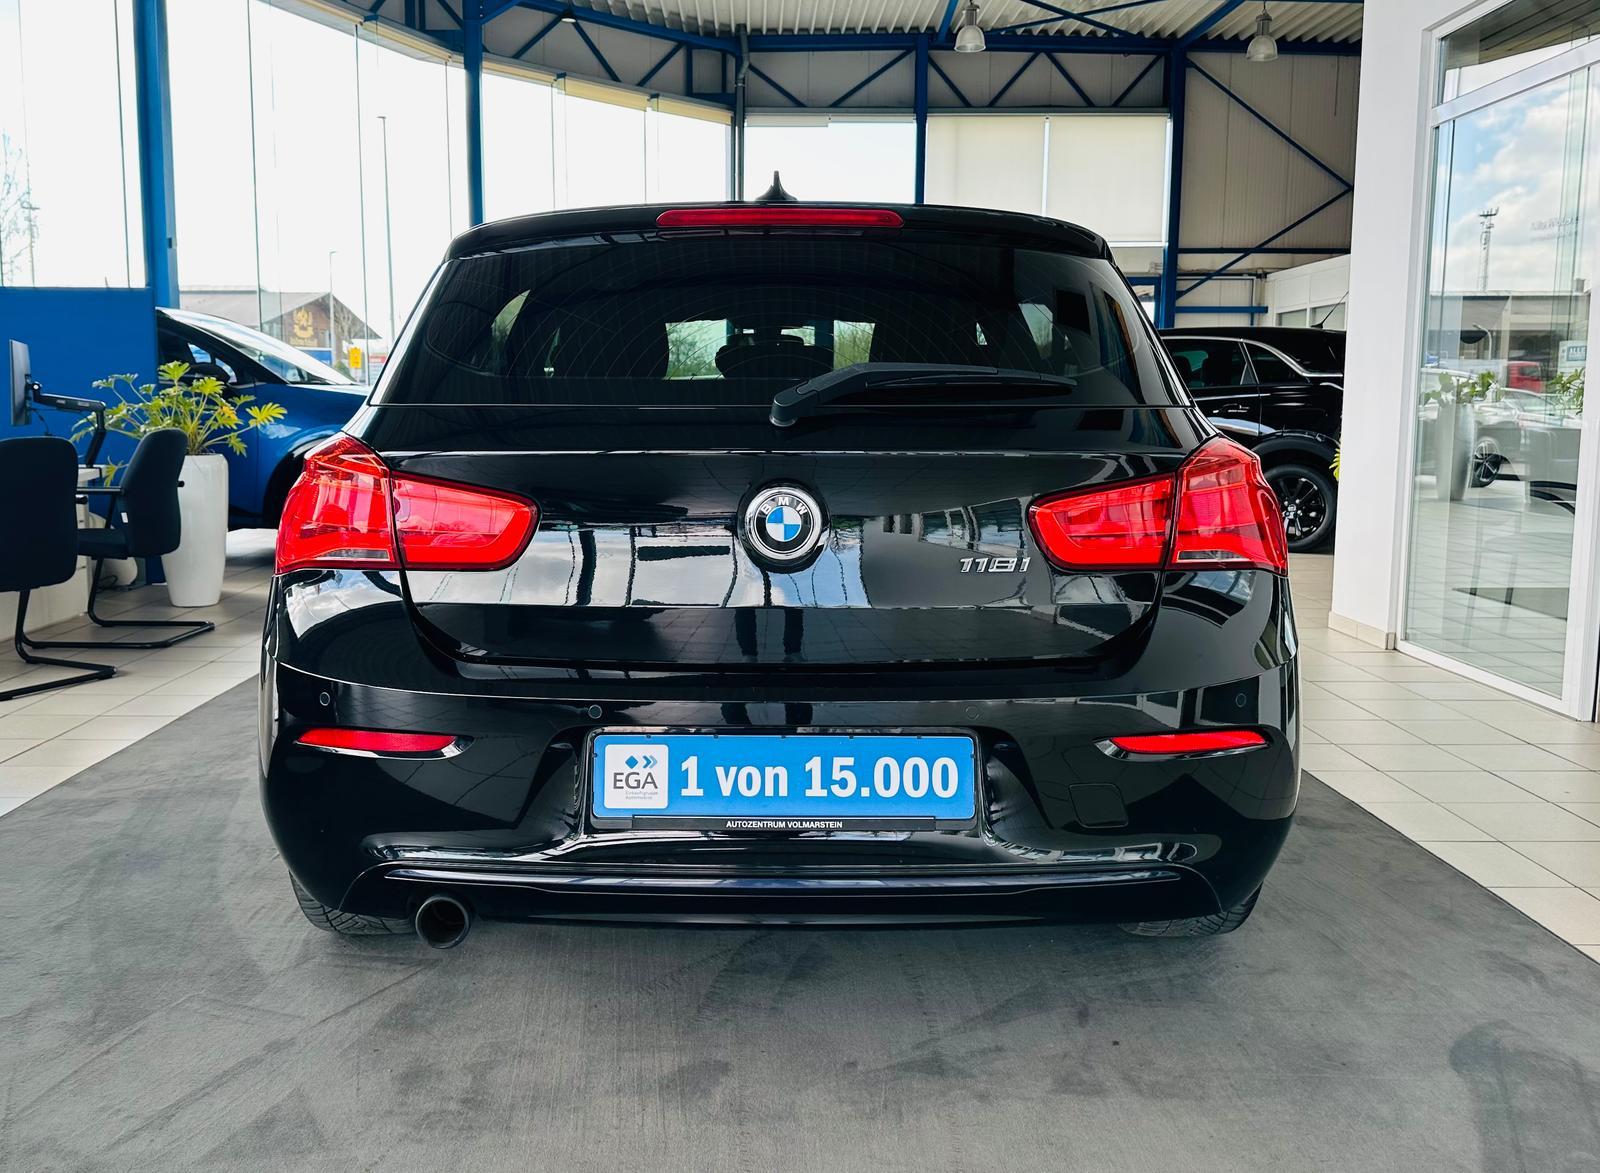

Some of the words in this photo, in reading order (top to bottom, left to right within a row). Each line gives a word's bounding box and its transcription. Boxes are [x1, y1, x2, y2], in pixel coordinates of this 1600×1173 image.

[760, 496, 808, 516] BMW
[613, 772, 658, 790] EGA
[680, 756, 704, 797] 1
[715, 766, 788, 797] von
[804, 756, 960, 798] 15.000
[725, 820, 786, 829] AUTOZENTRUM
[787, 821, 843, 829] VOLMARSTEIN
